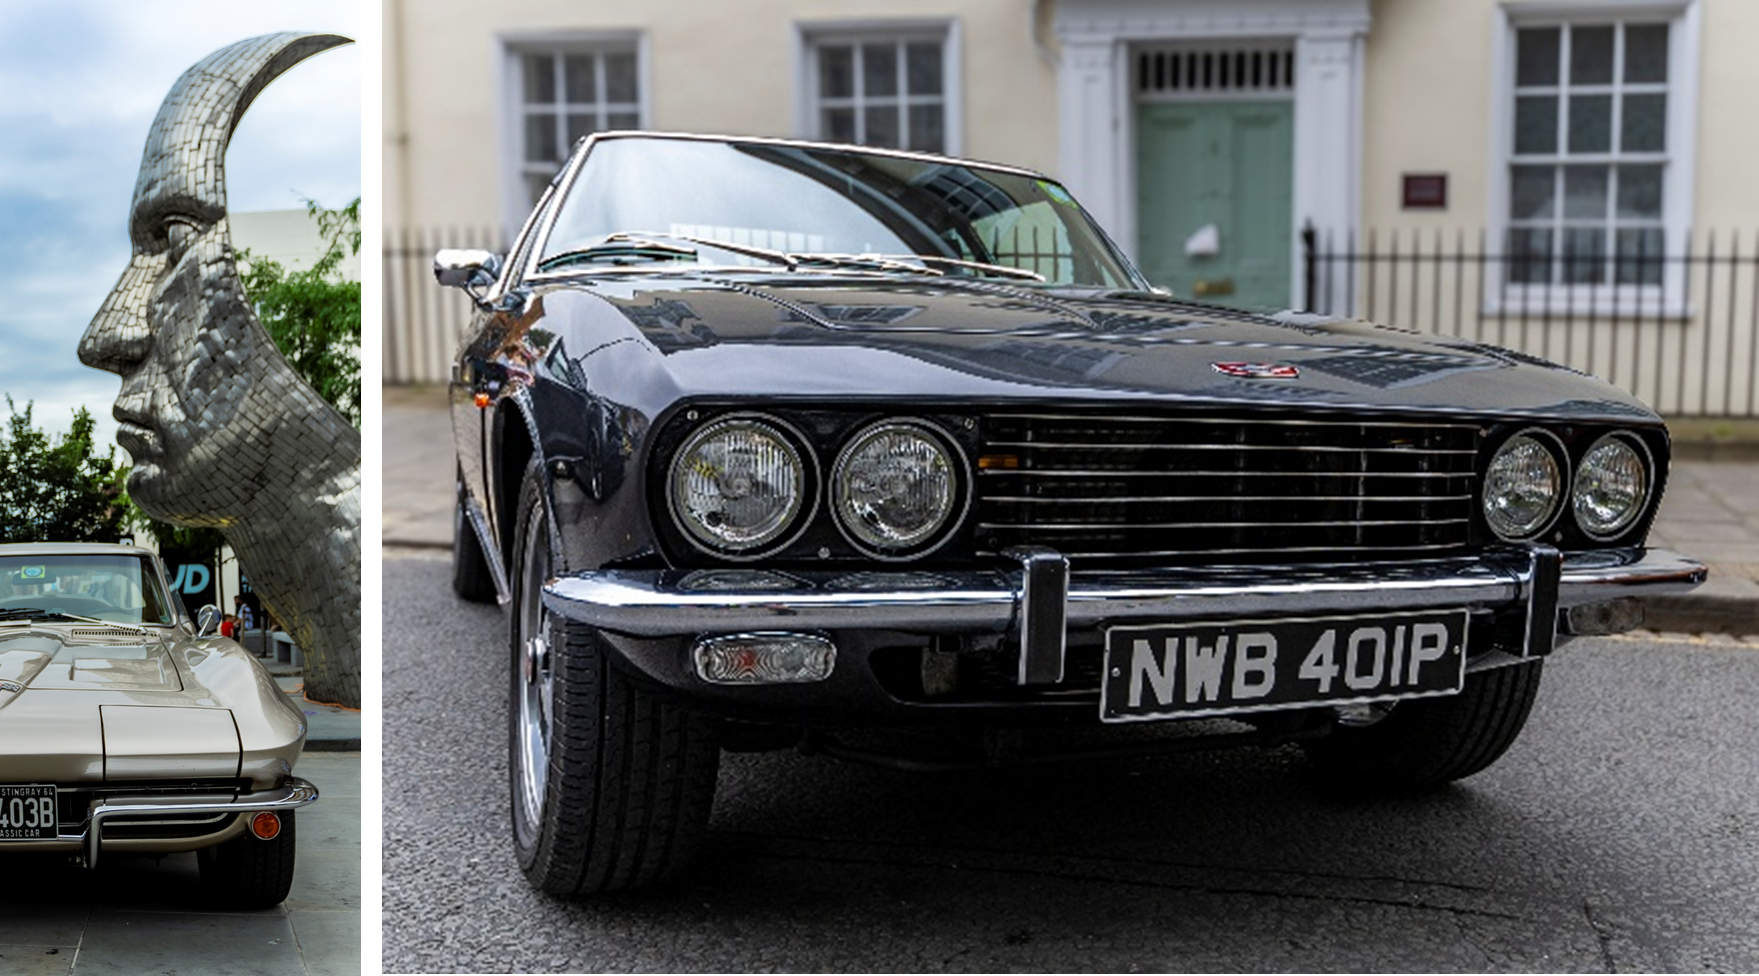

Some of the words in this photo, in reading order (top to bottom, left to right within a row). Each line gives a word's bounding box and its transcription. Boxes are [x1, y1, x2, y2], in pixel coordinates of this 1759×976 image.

[1128, 632, 1278, 708] NWB
[1298, 622, 1448, 694] 401P
[1, 787, 41, 797] STINGRAY
[43, 787, 53, 796] 64
[24, 829, 41, 838] CAR
